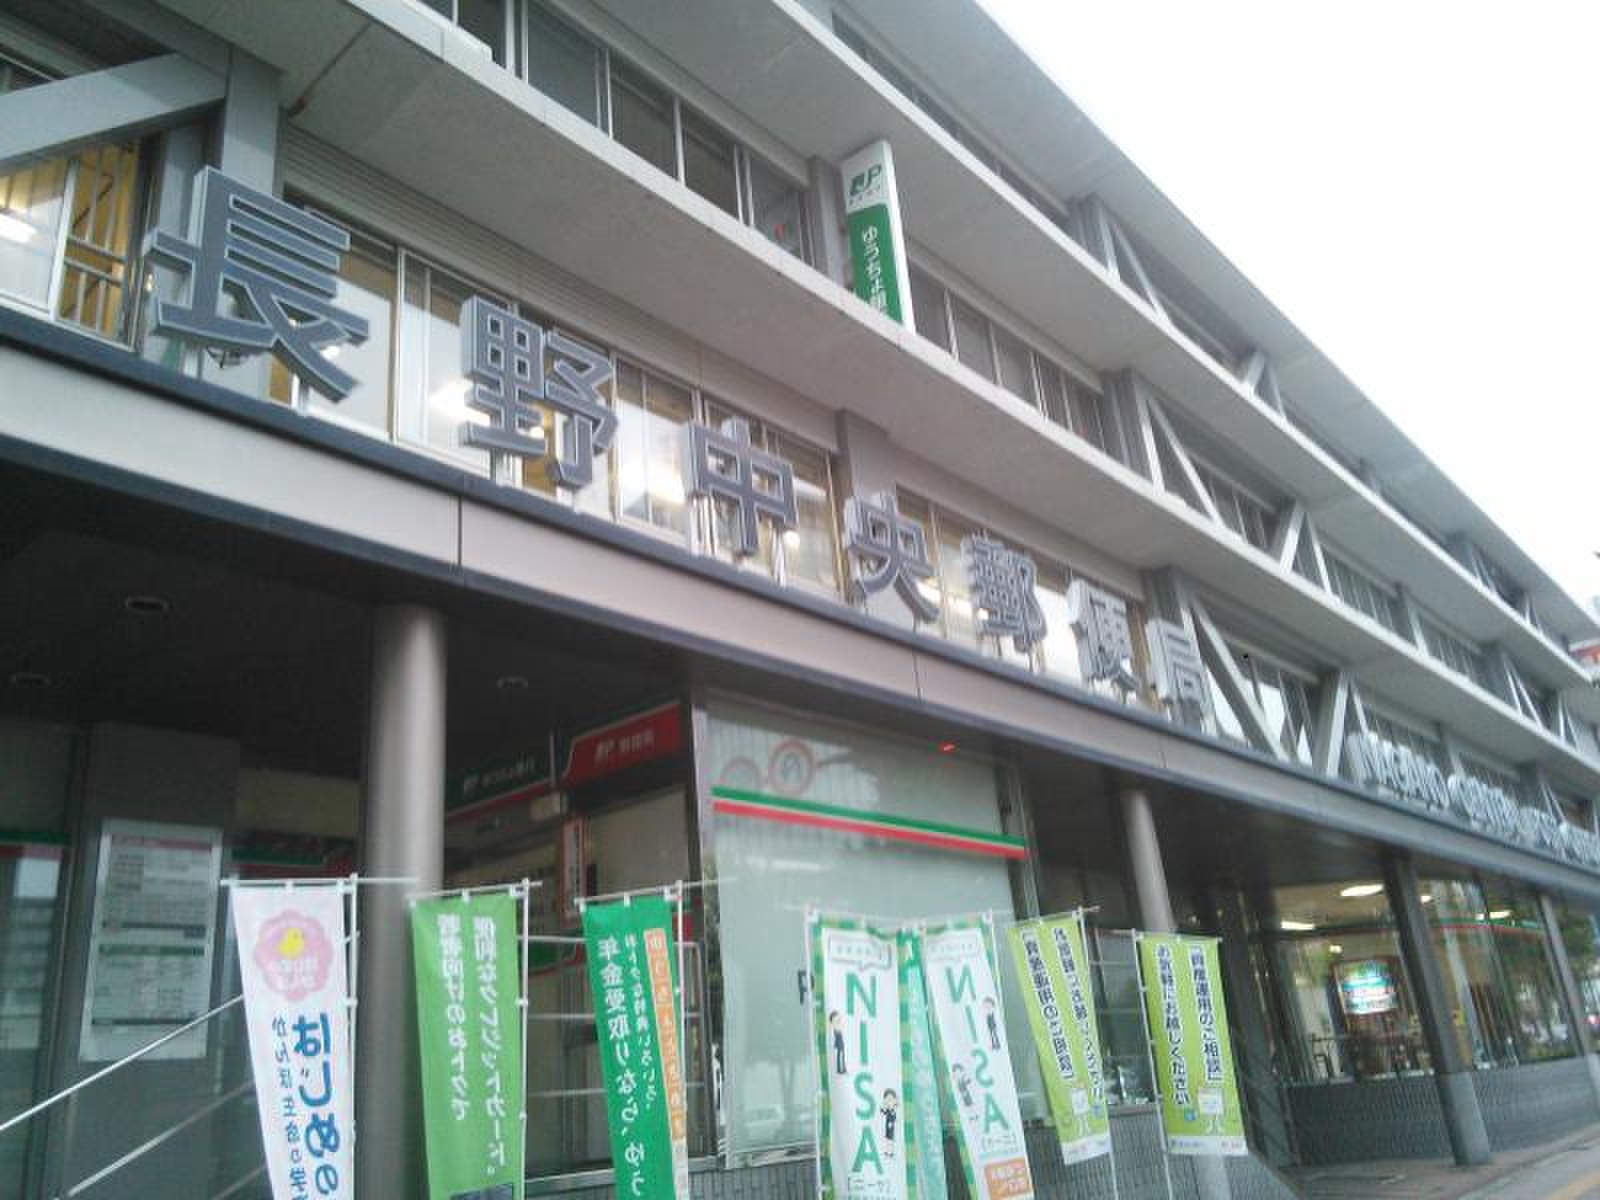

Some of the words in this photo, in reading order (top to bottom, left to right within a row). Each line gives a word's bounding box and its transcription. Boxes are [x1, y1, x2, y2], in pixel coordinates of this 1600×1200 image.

[143, 165, 1214, 730] 長野中央郵便局
[845, 972, 884, 1174] NISA
